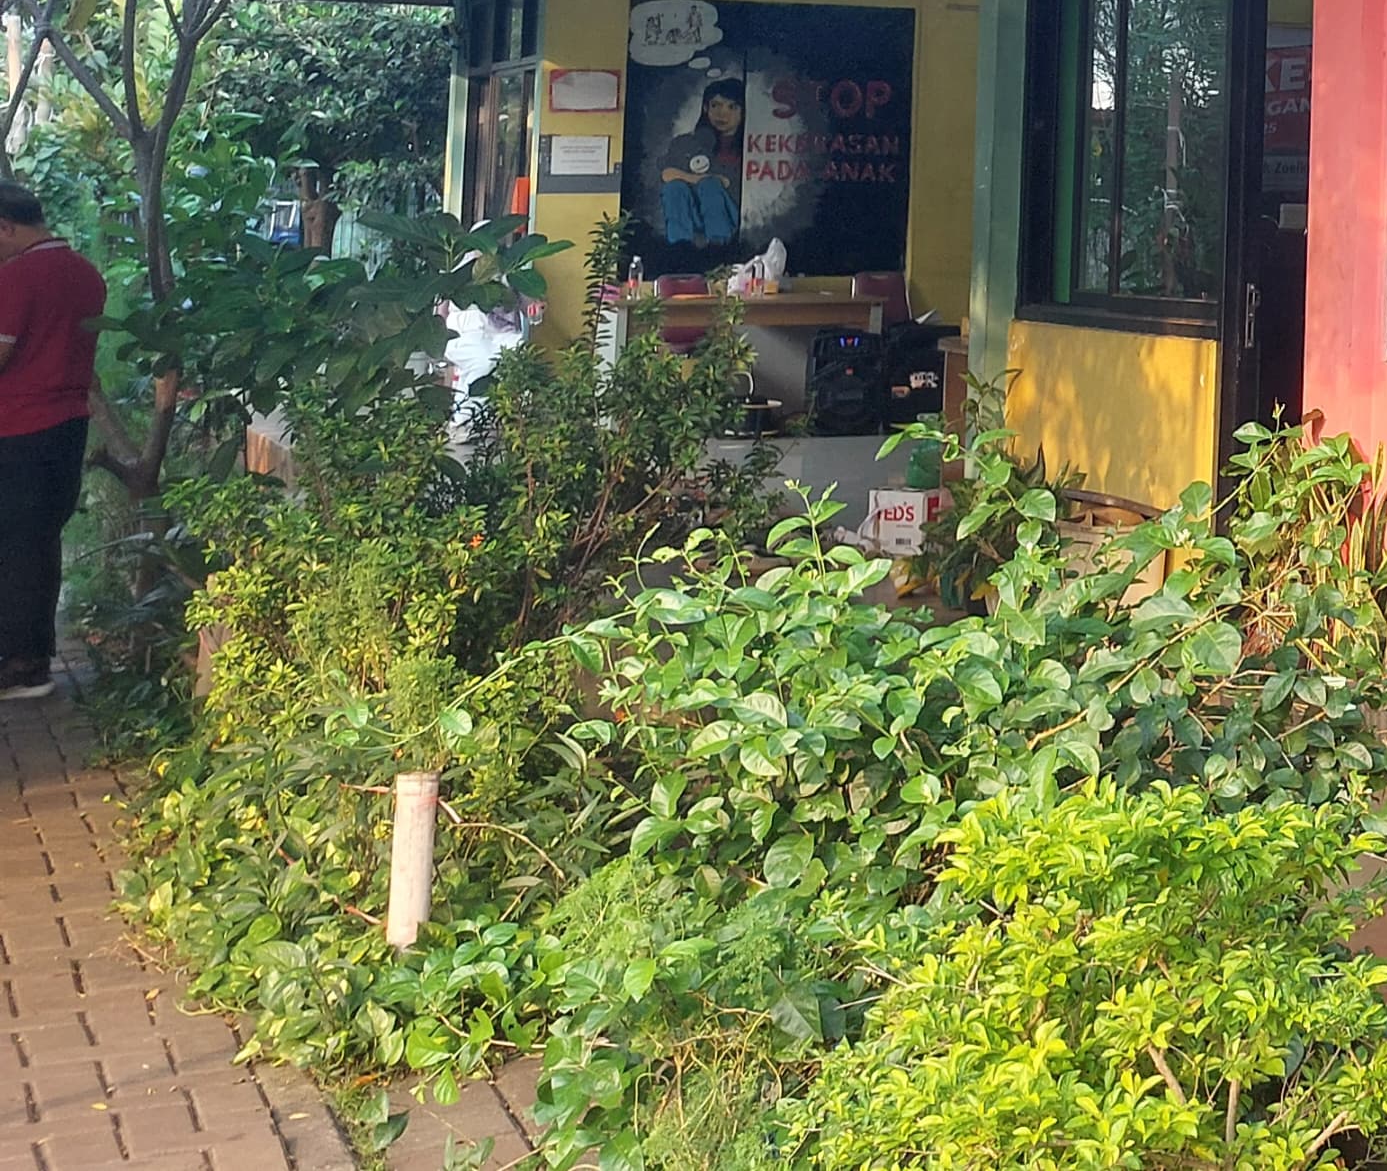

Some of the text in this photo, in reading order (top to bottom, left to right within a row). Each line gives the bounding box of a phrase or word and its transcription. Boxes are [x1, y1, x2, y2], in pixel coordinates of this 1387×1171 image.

[746, 133, 900, 156] KEKERASAN
[745, 159, 898, 183] PADA ANAK
